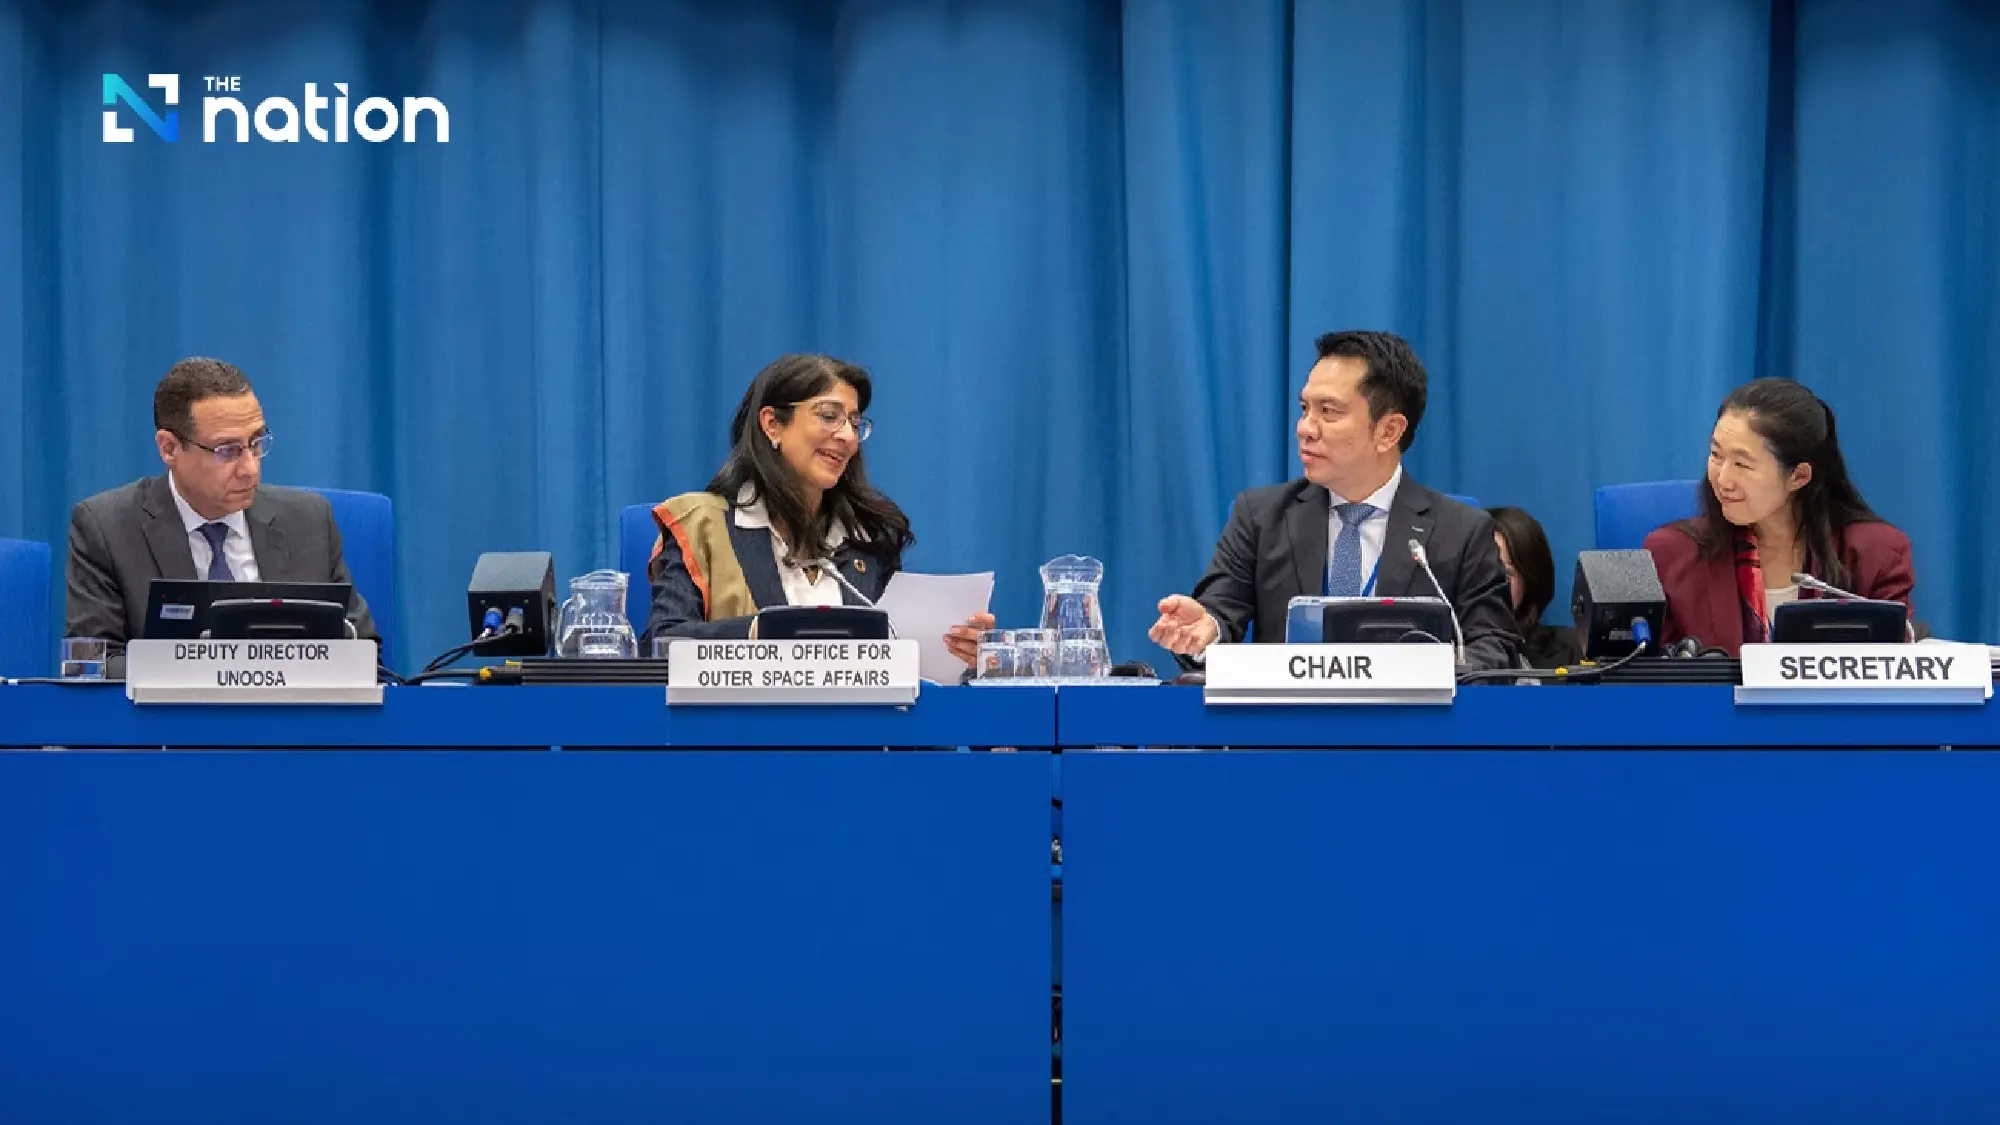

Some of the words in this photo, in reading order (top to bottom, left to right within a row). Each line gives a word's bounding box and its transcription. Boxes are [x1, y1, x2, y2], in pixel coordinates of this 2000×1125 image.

[175, 643, 239, 660] DEPUTY
[247, 643, 330, 660] DIRECTOR
[697, 644, 783, 662] DIRECTOR,
[791, 644, 849, 660] OFFICE
[857, 644, 892, 660] FOR
[1288, 655, 1373, 680] CHAIR
[1779, 656, 1955, 680] SECRETARY
[217, 670, 286, 687] UNOOSA
[698, 670, 753, 687] OUTER
[762, 670, 815, 687] SPACE
[822, 670, 890, 687] AFFAIRS
